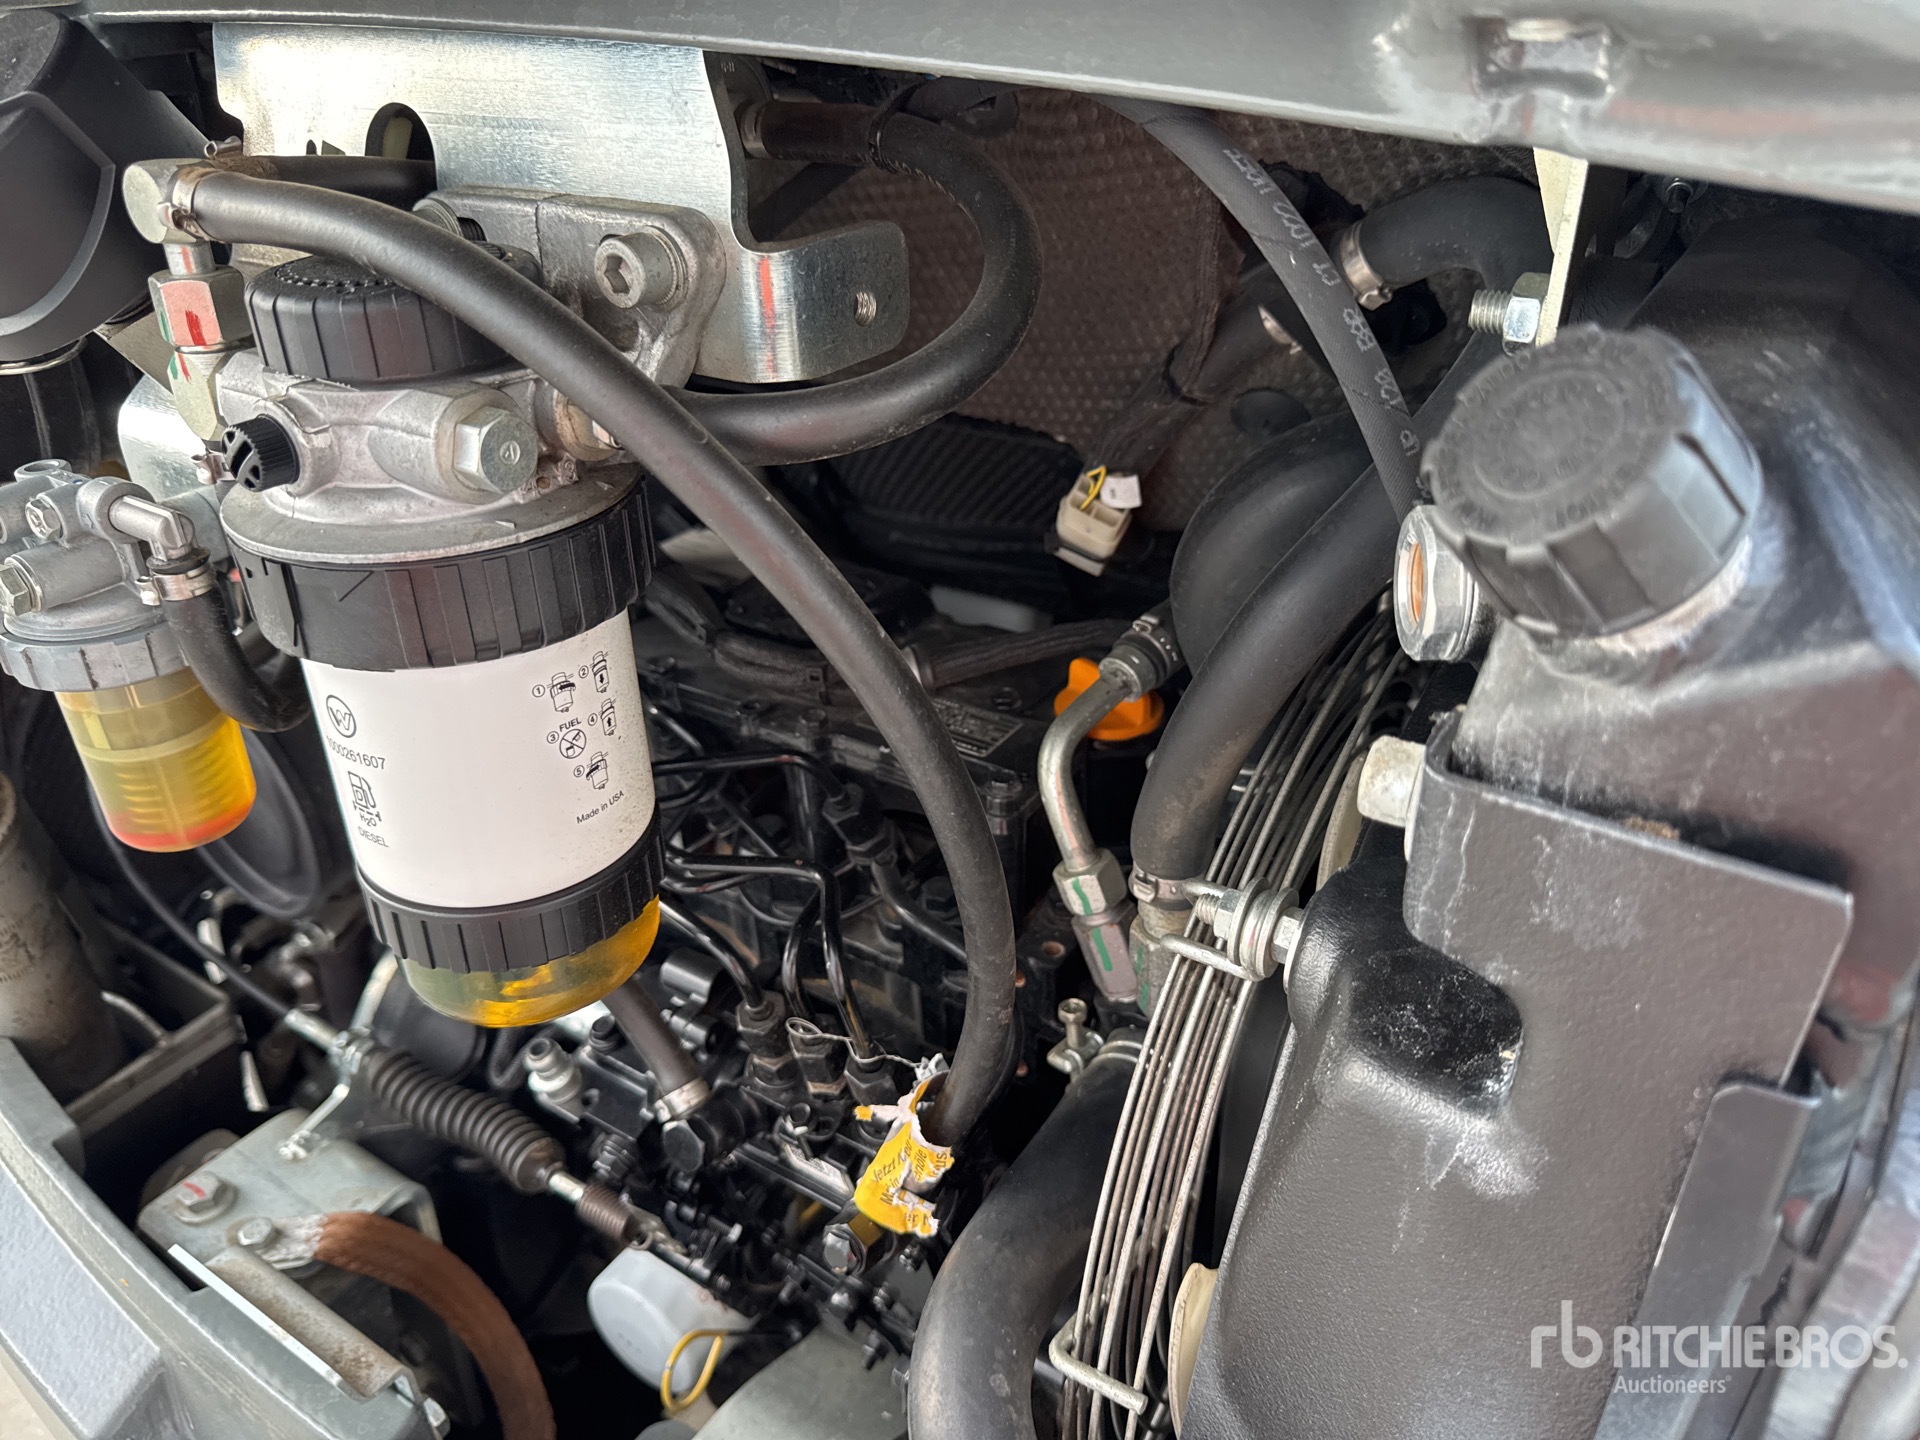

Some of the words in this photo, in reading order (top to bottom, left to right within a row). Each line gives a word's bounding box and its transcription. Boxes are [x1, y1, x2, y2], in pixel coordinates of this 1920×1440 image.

[559, 717, 582, 732] FUEL
[576, 808, 600, 825] Made
[600, 803, 609, 813] in
[608, 790, 625, 807] USA
[357, 825, 390, 848] DIESEL
